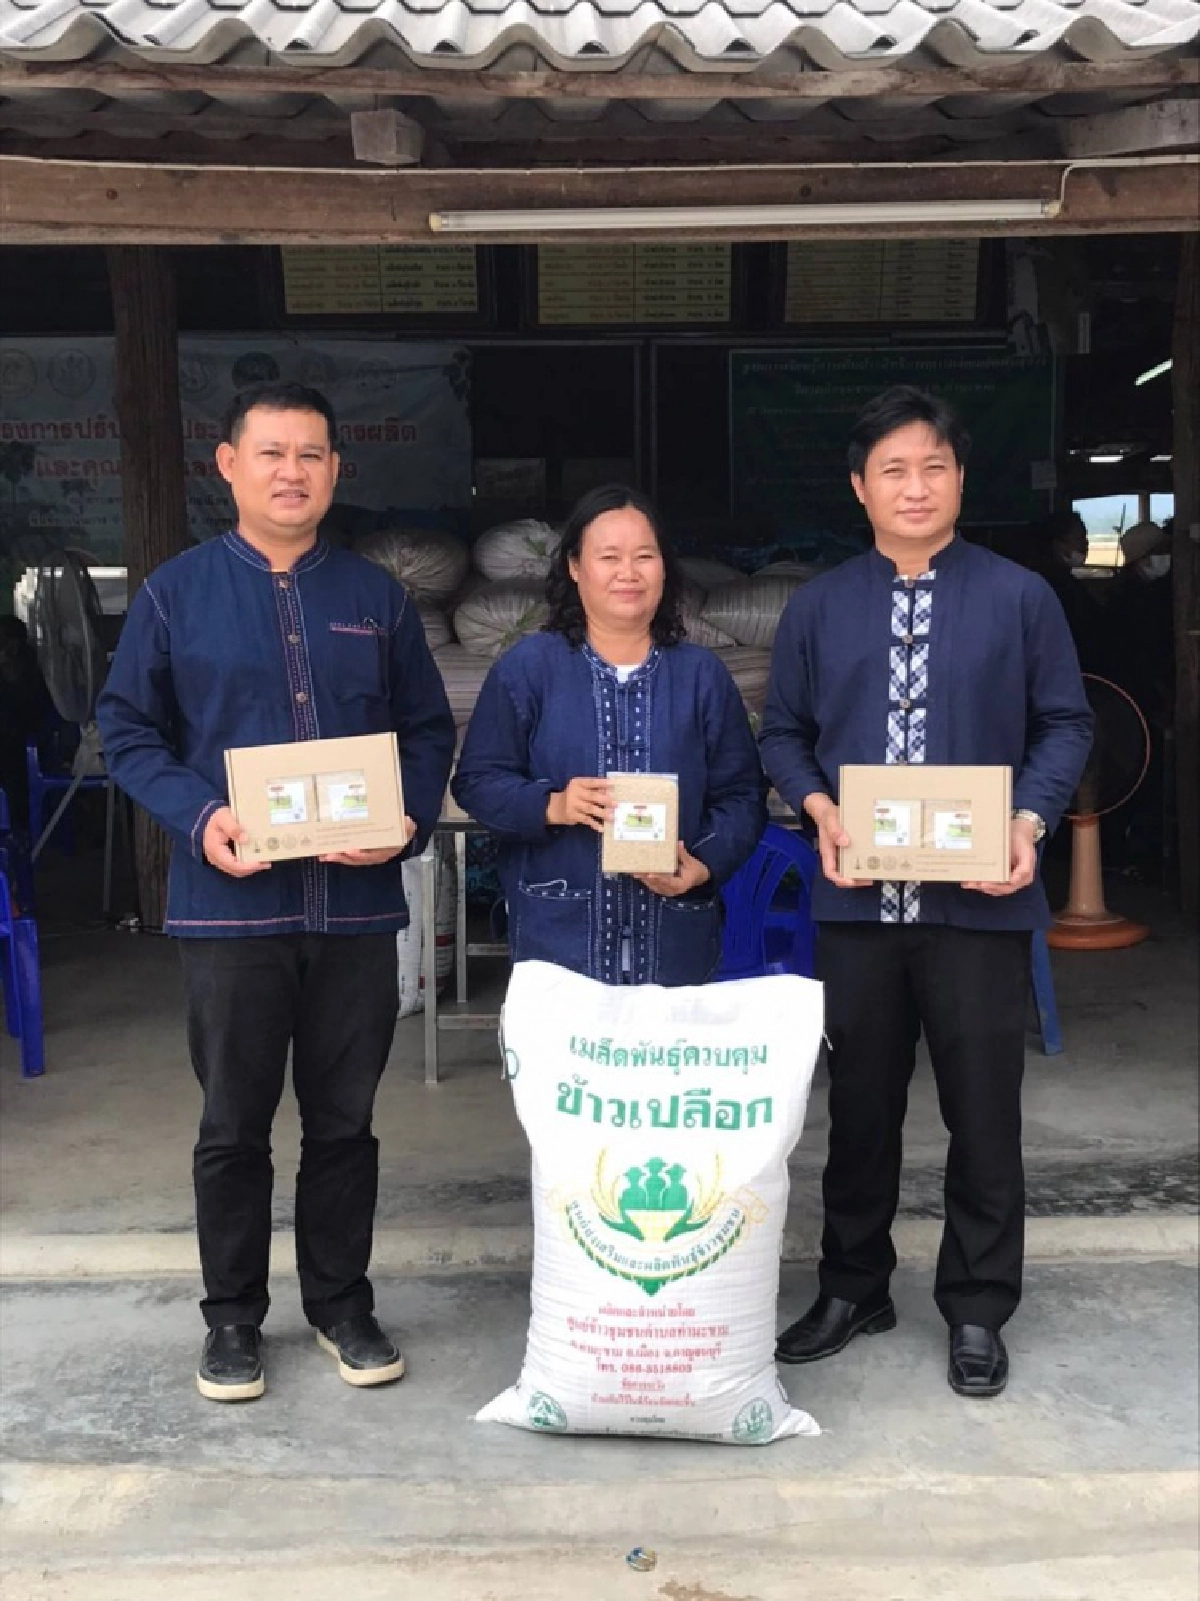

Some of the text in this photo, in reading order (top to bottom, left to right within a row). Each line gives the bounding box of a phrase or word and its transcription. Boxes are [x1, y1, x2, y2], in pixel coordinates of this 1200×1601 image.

[569, 1035, 768, 1075] เมล็ดพันธุ์ควบคุม
[556, 1073, 774, 1131] ข้าวเปลือก
